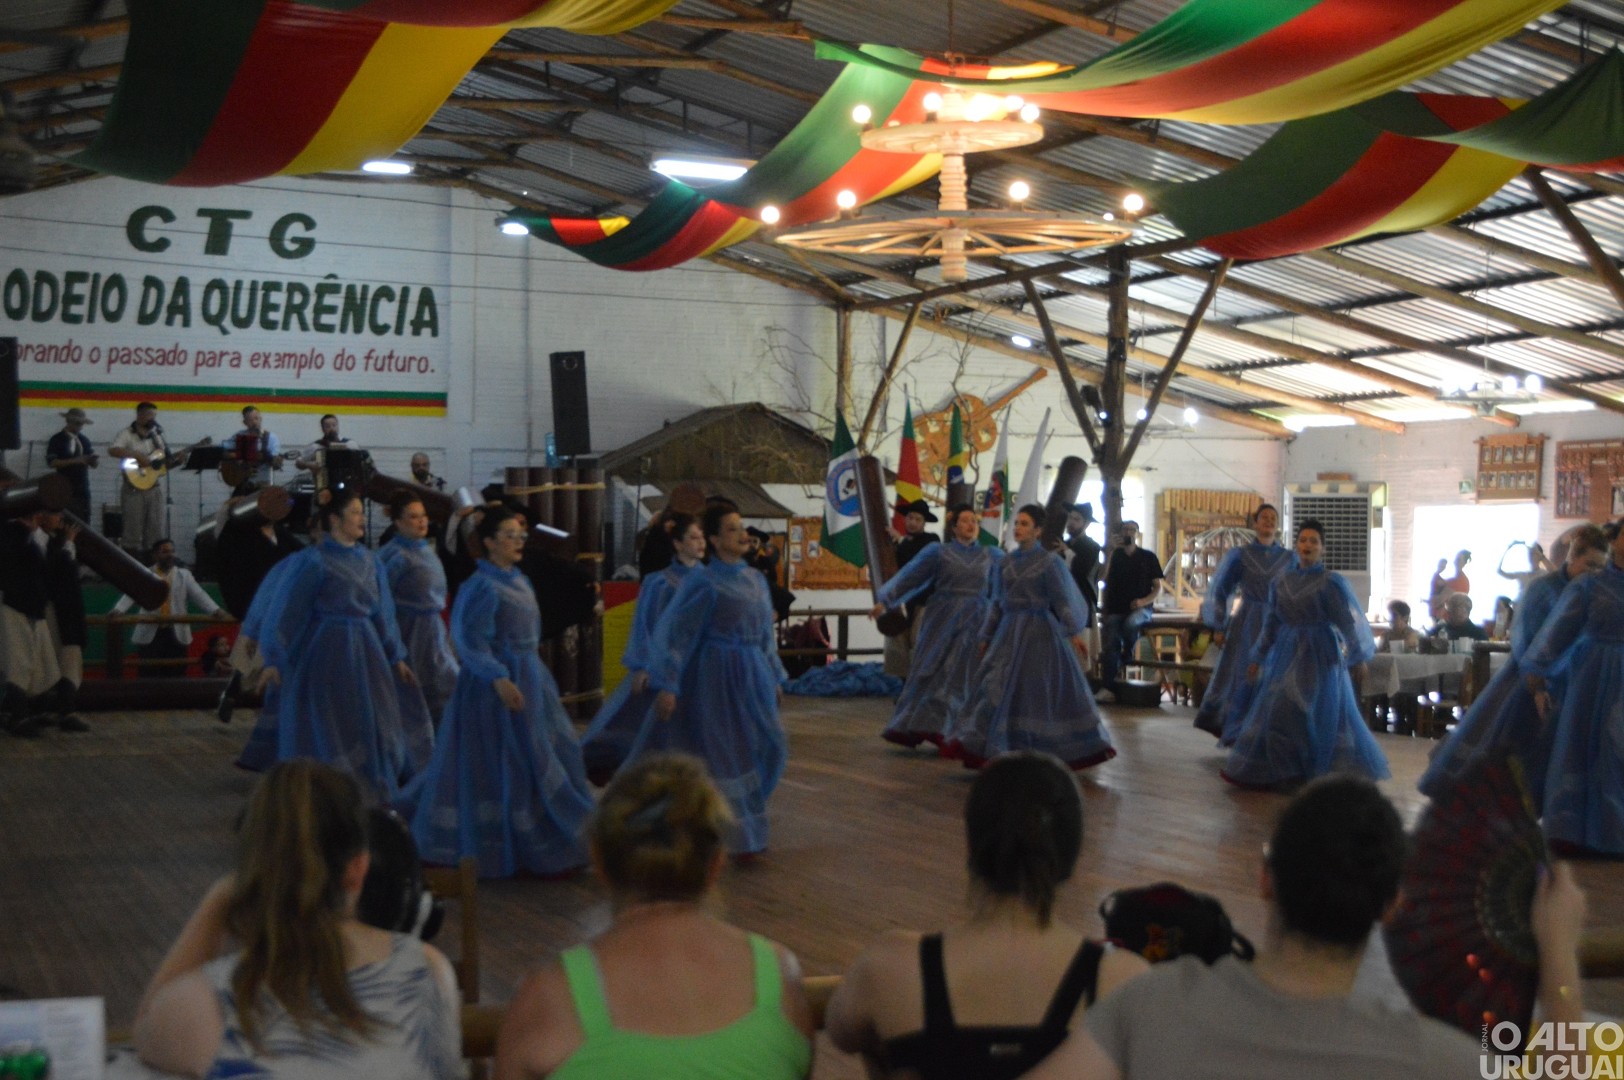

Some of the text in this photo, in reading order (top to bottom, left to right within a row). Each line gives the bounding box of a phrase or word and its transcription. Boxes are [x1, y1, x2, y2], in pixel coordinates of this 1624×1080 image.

[137, 275, 191, 328] DA
[202, 273, 439, 337] QUERÊNCIA
[89, 347, 100, 363] o
[107, 342, 187, 374] passado
[195, 348, 241, 376] para
[250, 347, 325, 379] exemplo
[333, 348, 356, 371] do
[364, 349, 435, 373] futuro.
